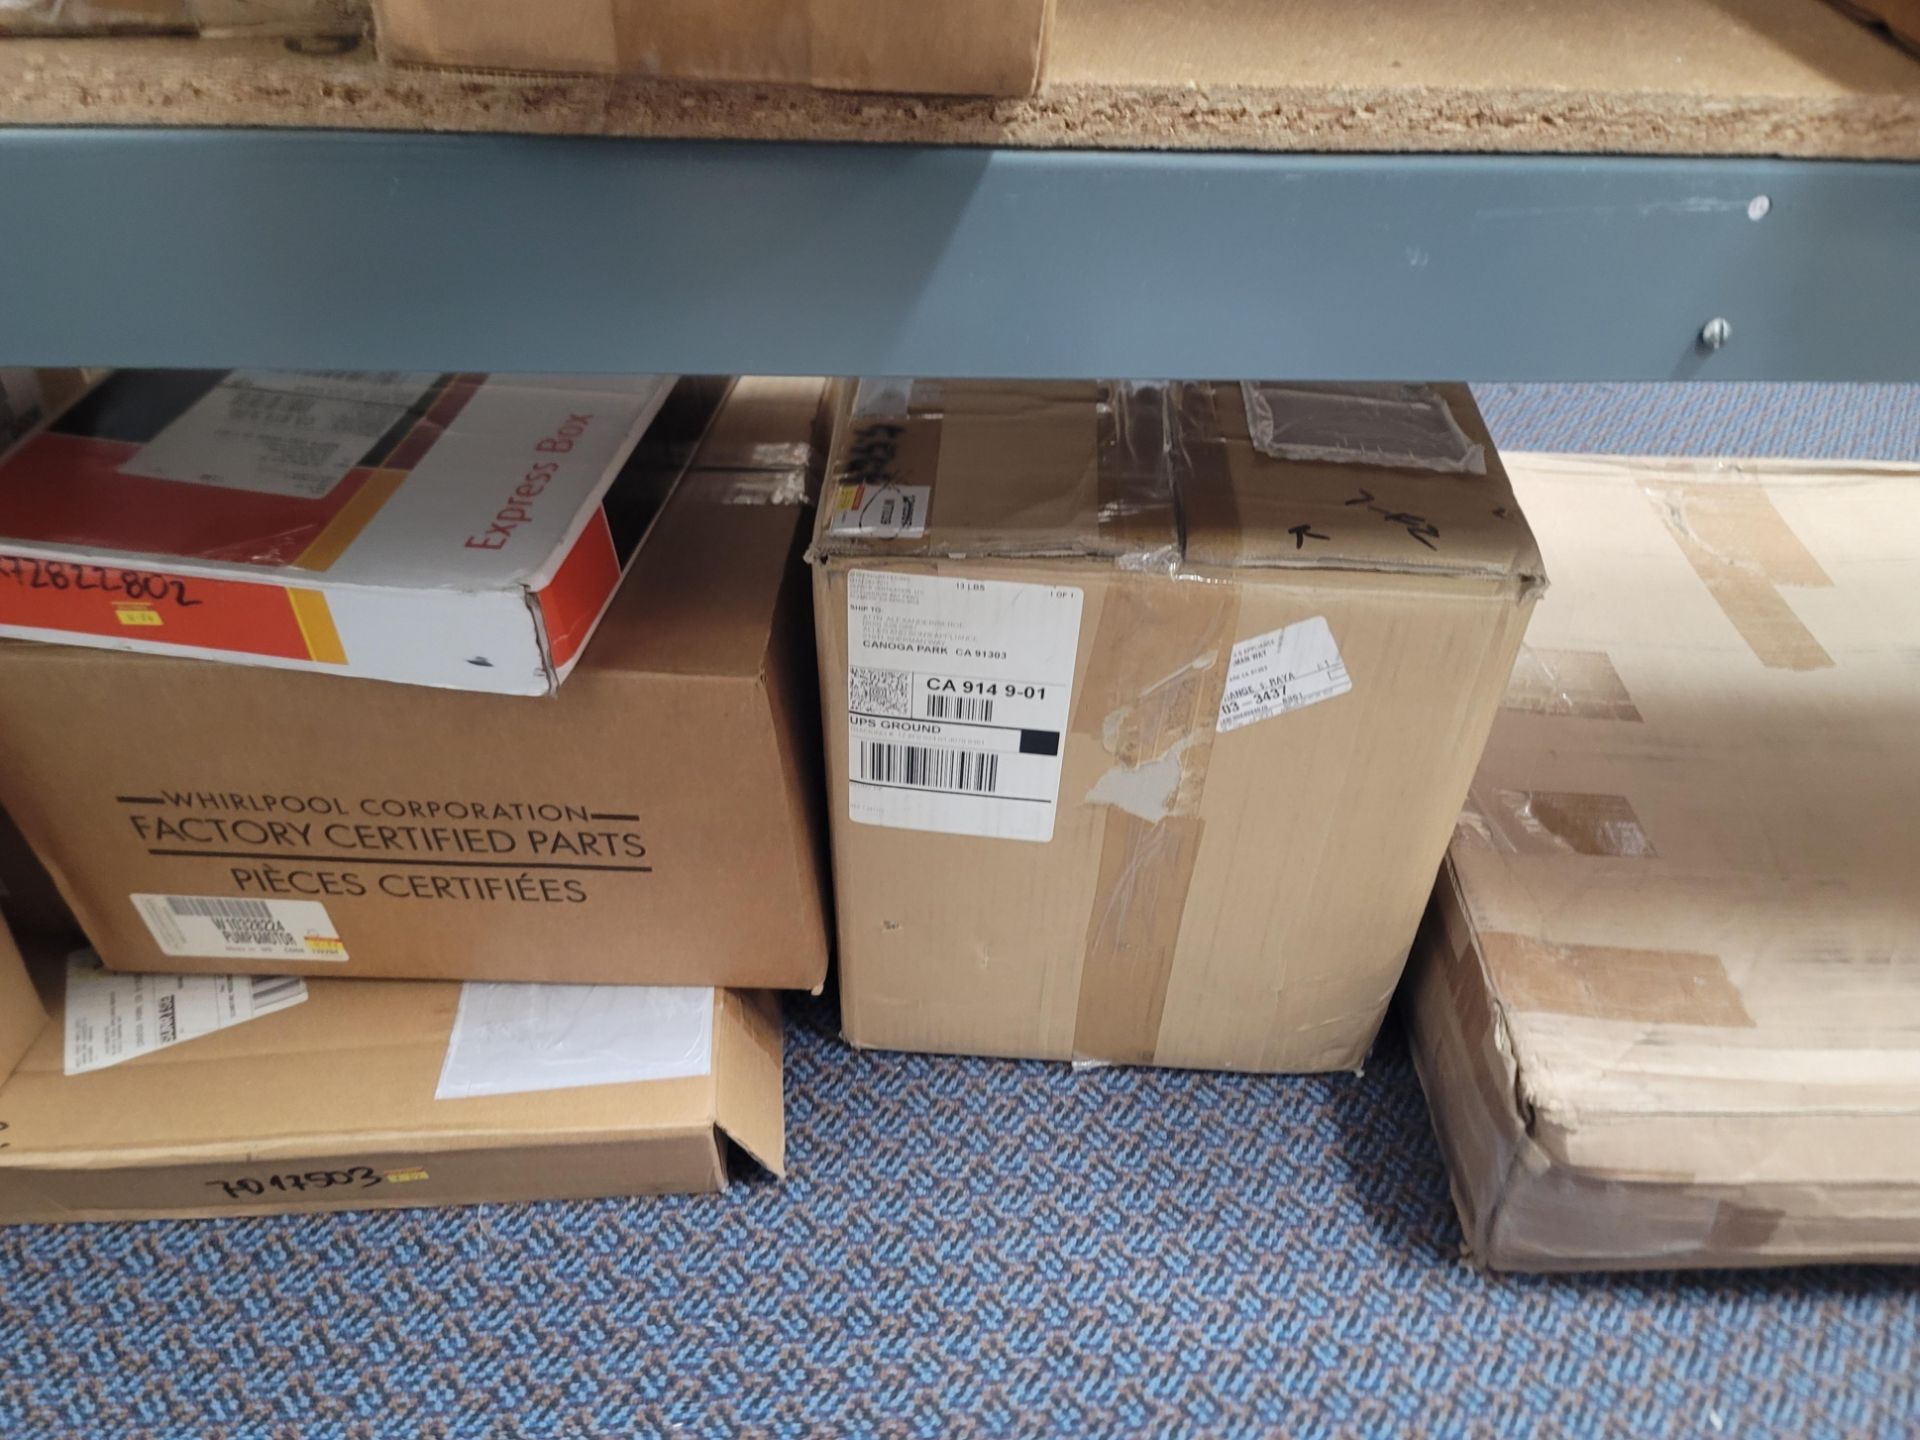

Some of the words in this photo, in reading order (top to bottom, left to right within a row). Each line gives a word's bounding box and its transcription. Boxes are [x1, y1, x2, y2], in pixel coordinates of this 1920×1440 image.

[464, 462, 559, 550] Express
[535, 413, 594, 453] Box
[863, 640, 914, 652] CANOGA
[916, 645, 948, 655] PARK
[955, 648, 972, 657] CA
[926, 677, 956, 693] CA
[962, 680, 998, 697] 914
[1004, 684, 1046, 700] 9-01
[849, 717, 877, 728] UPS
[880, 720, 942, 734] GROUND
[161, 790, 349, 816] WHIRLPOOL
[360, 799, 589, 823] CORPORATION
[129, 814, 311, 847] FACTORY
[324, 823, 517, 853] CERTIFIED
[527, 829, 647, 858] PARTS
[230, 863, 367, 897] PIÈCES
[378, 872, 588, 903] CERTIFIÉES
